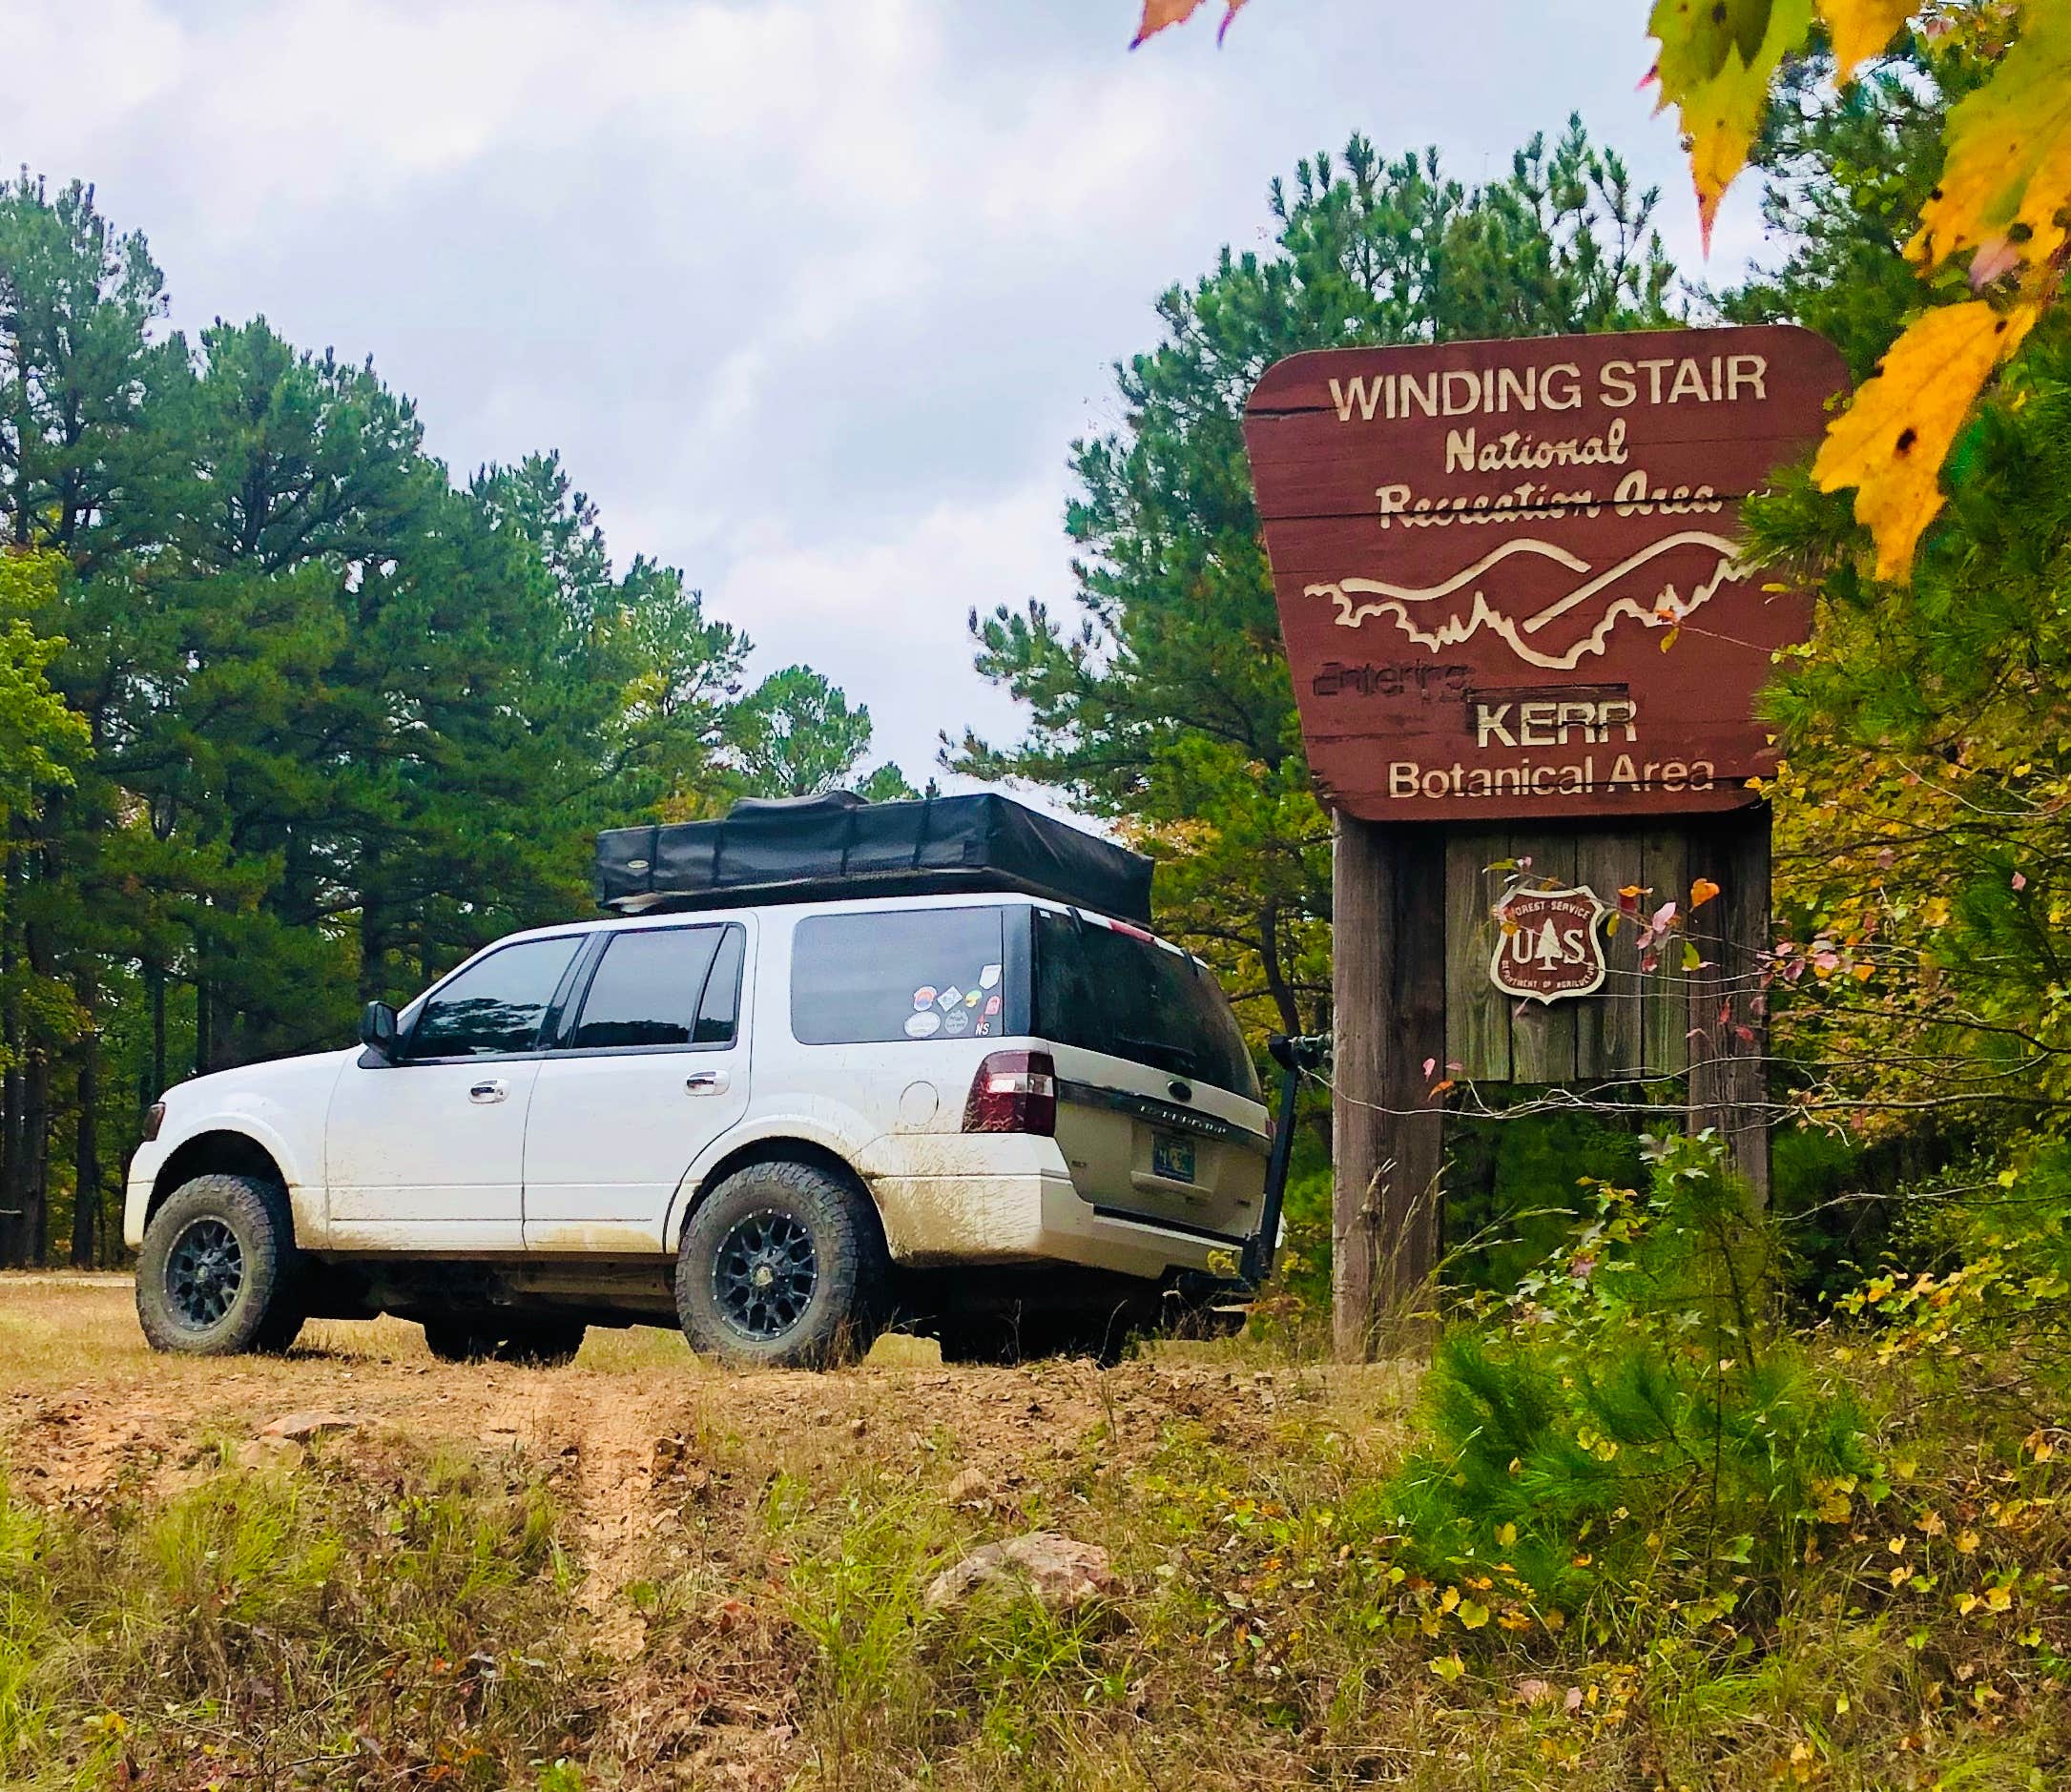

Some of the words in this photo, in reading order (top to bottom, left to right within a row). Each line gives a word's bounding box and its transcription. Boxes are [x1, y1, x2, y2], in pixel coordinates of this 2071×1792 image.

[1329, 362, 1582, 422] WINDING
[1599, 354, 1768, 407] STAIR
[1445, 418, 1628, 473] National
[1375, 481, 1602, 529] Recreation
[1613, 469, 1723, 517] Area
[1477, 700, 1637, 748] KERR
[1389, 756, 1593, 799] Botanical
[1606, 753, 1715, 793] Area
[1515, 900, 1545, 917] OREST
[1550, 900, 1590, 919] SERVICE
[975, 1022, 989, 1037] NS
